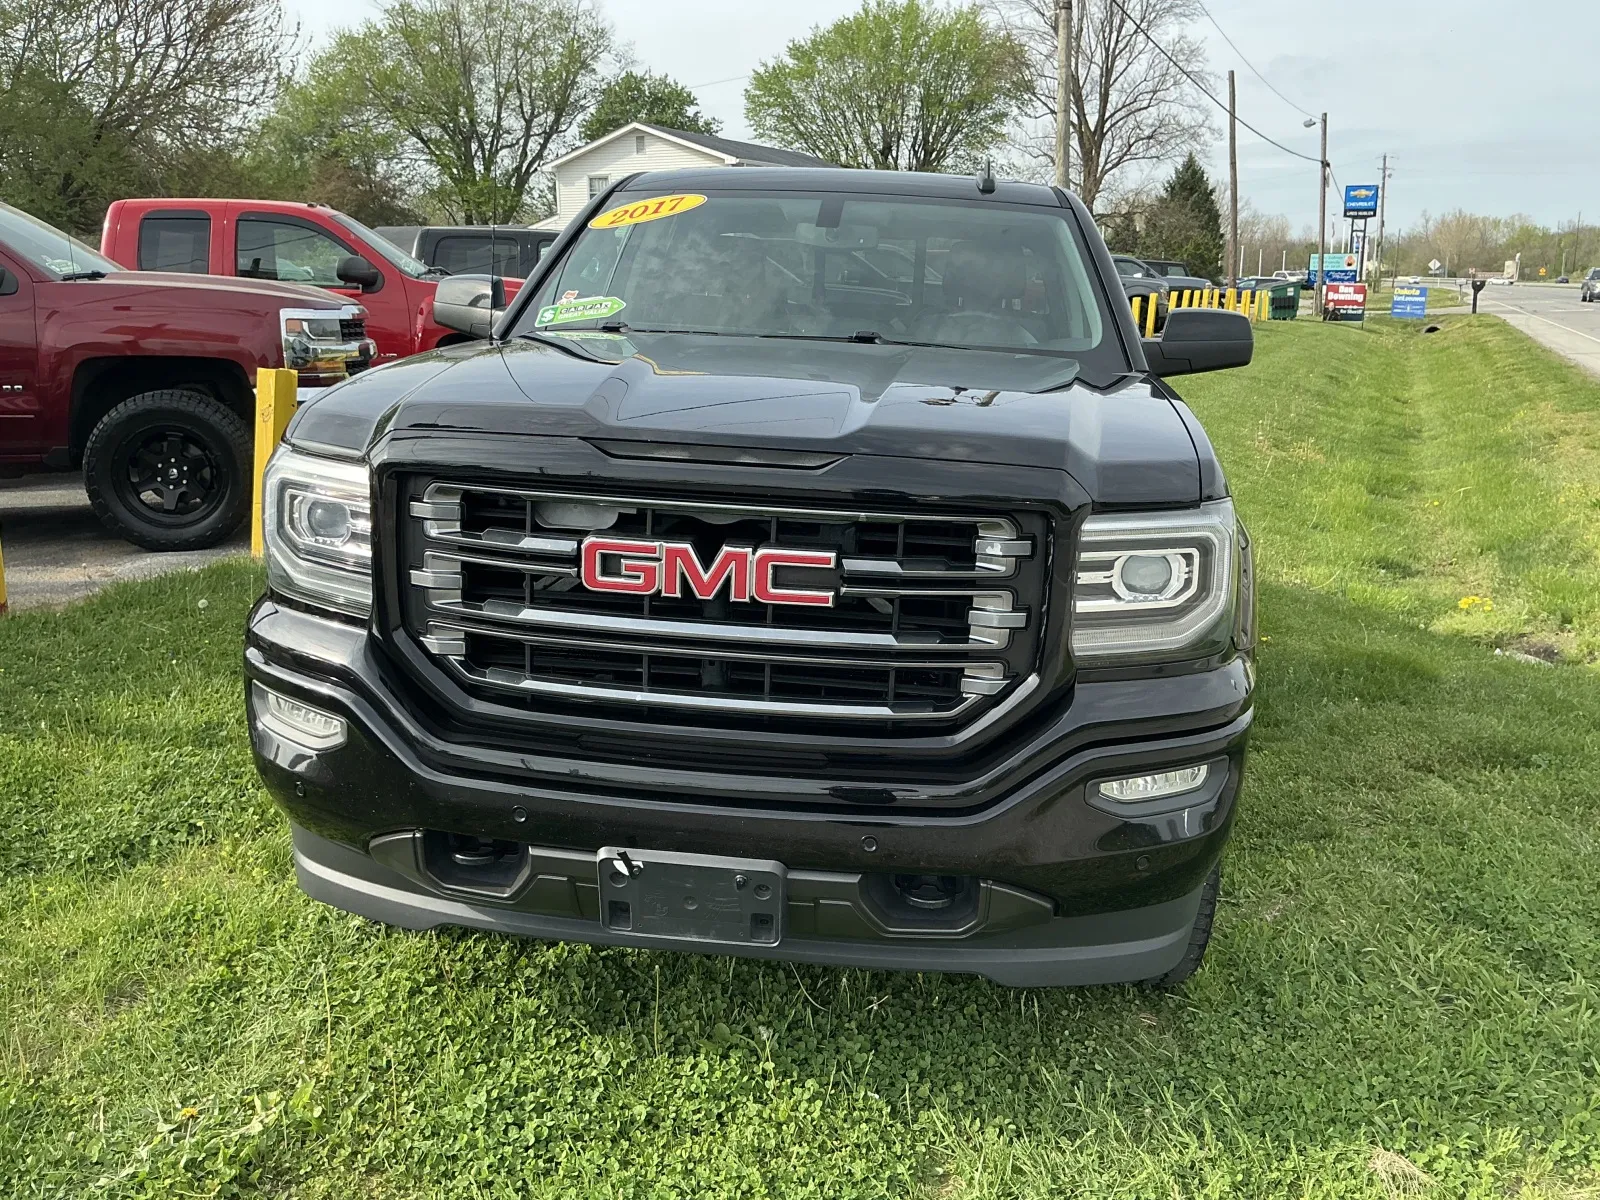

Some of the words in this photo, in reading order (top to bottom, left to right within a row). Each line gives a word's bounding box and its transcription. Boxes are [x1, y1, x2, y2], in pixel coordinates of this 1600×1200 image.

[608, 196, 686, 226] 2017
[1327, 291, 1364, 303] Downing
[1394, 287, 1420, 296] Dakota
[559, 301, 612, 314] CARFAX
[558, 311, 584, 320] GREAT
[581, 535, 837, 608] GMC
